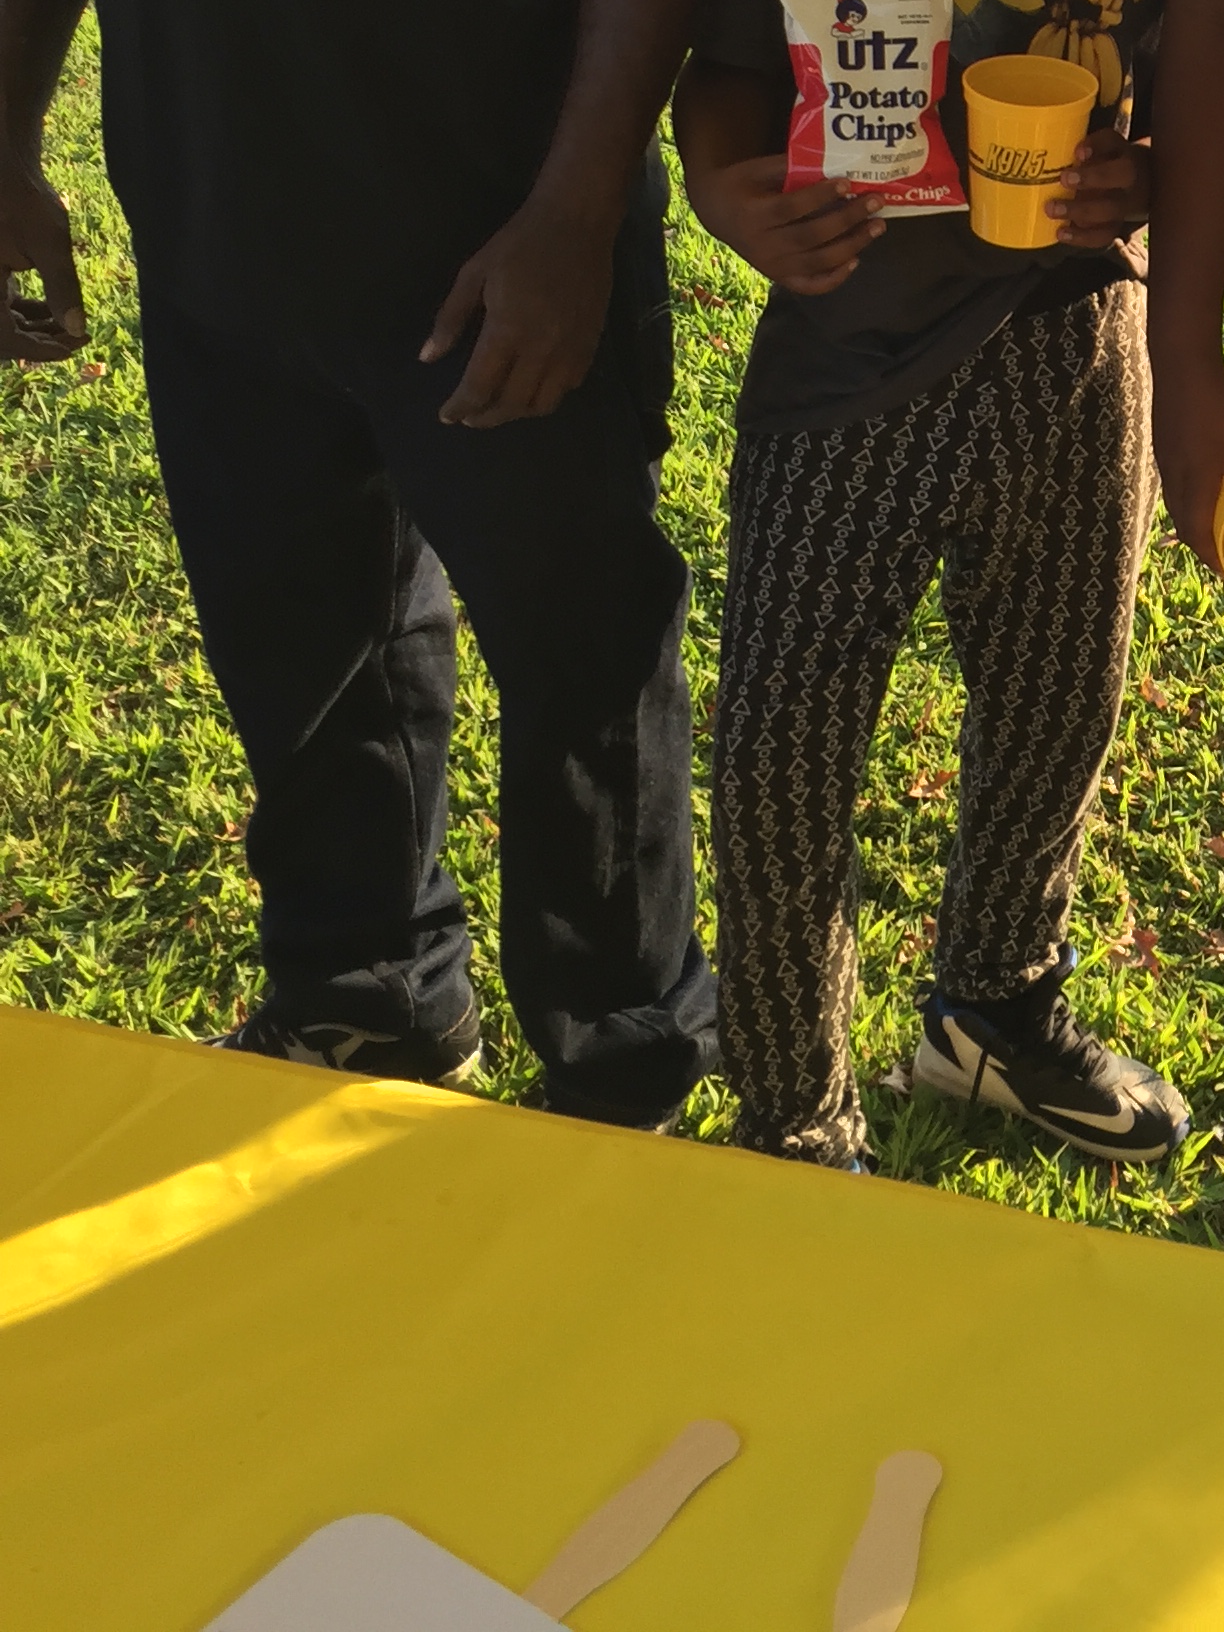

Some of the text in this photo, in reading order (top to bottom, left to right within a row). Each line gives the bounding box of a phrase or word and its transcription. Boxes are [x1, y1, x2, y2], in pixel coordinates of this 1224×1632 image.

[829, 81, 928, 109] Potato
[832, 113, 917, 147] Chips
[905, 184, 951, 202] Chips
